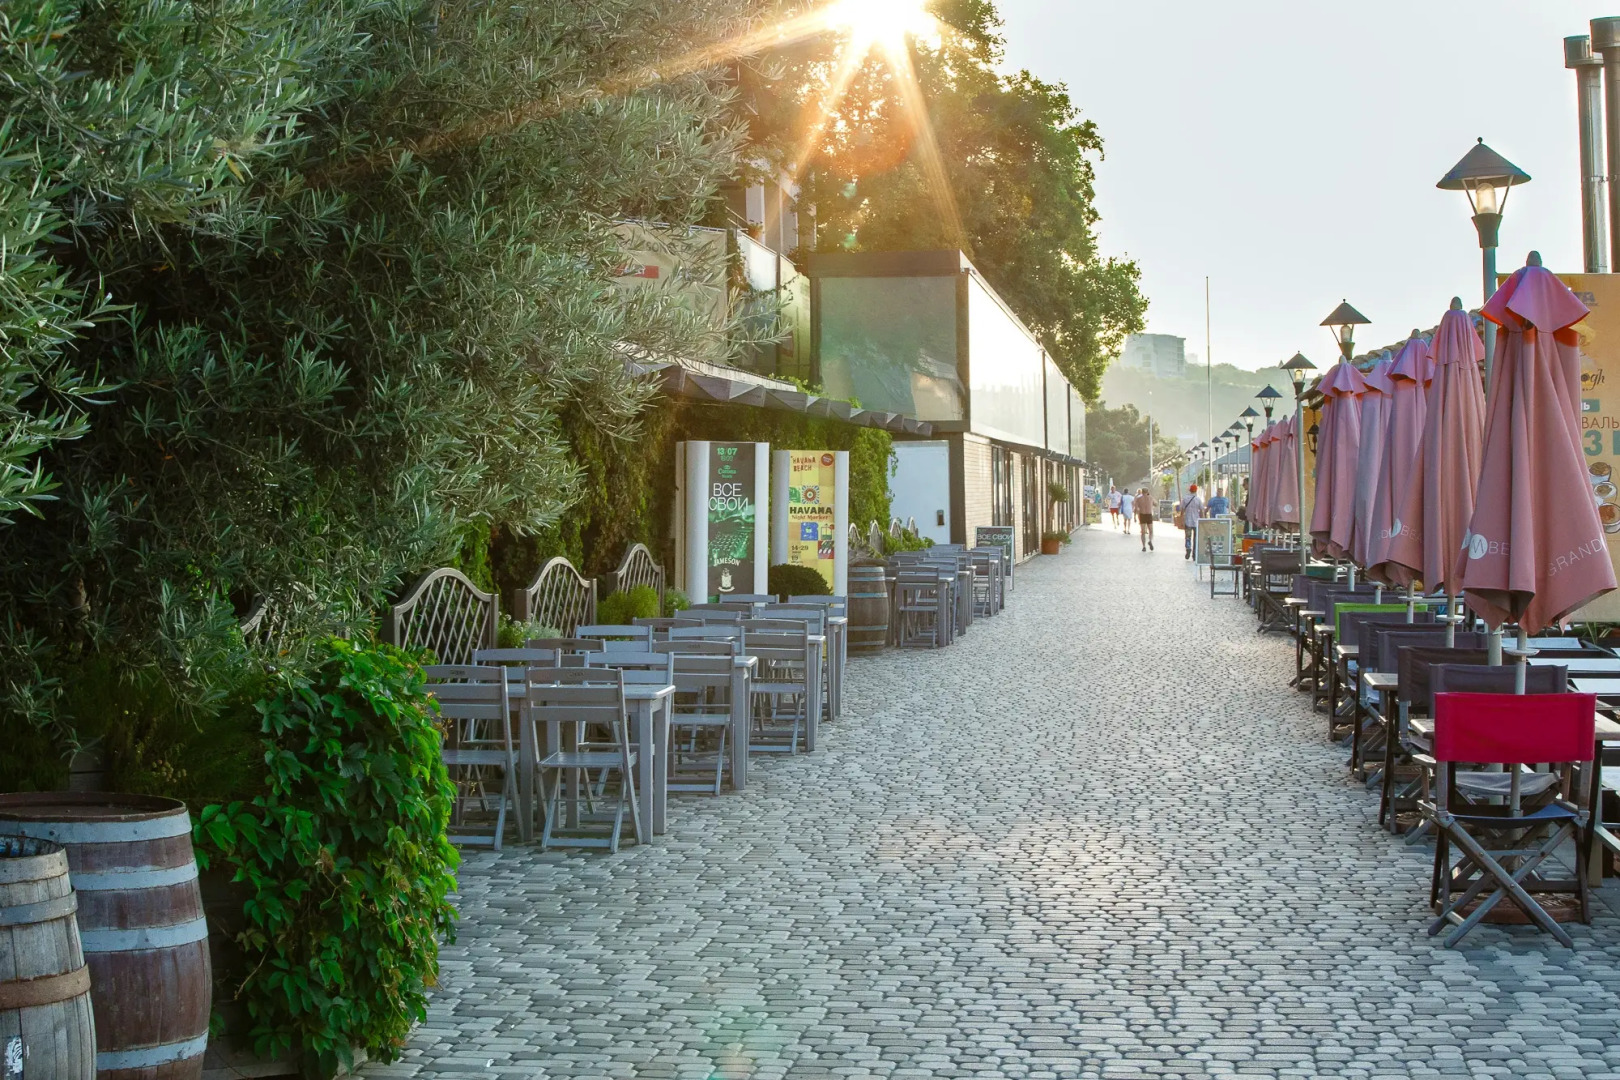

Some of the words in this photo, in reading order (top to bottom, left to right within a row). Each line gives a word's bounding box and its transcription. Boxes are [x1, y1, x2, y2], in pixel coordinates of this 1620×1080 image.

[792, 456, 817, 464] HAVANA
[713, 482, 743, 497] ВСЕ
[708, 496, 749, 511] СВОИ
[789, 506, 833, 515] HAVANA
[713, 556, 741, 567] JAMESON
[1548, 538, 1603, 577] GRAND
